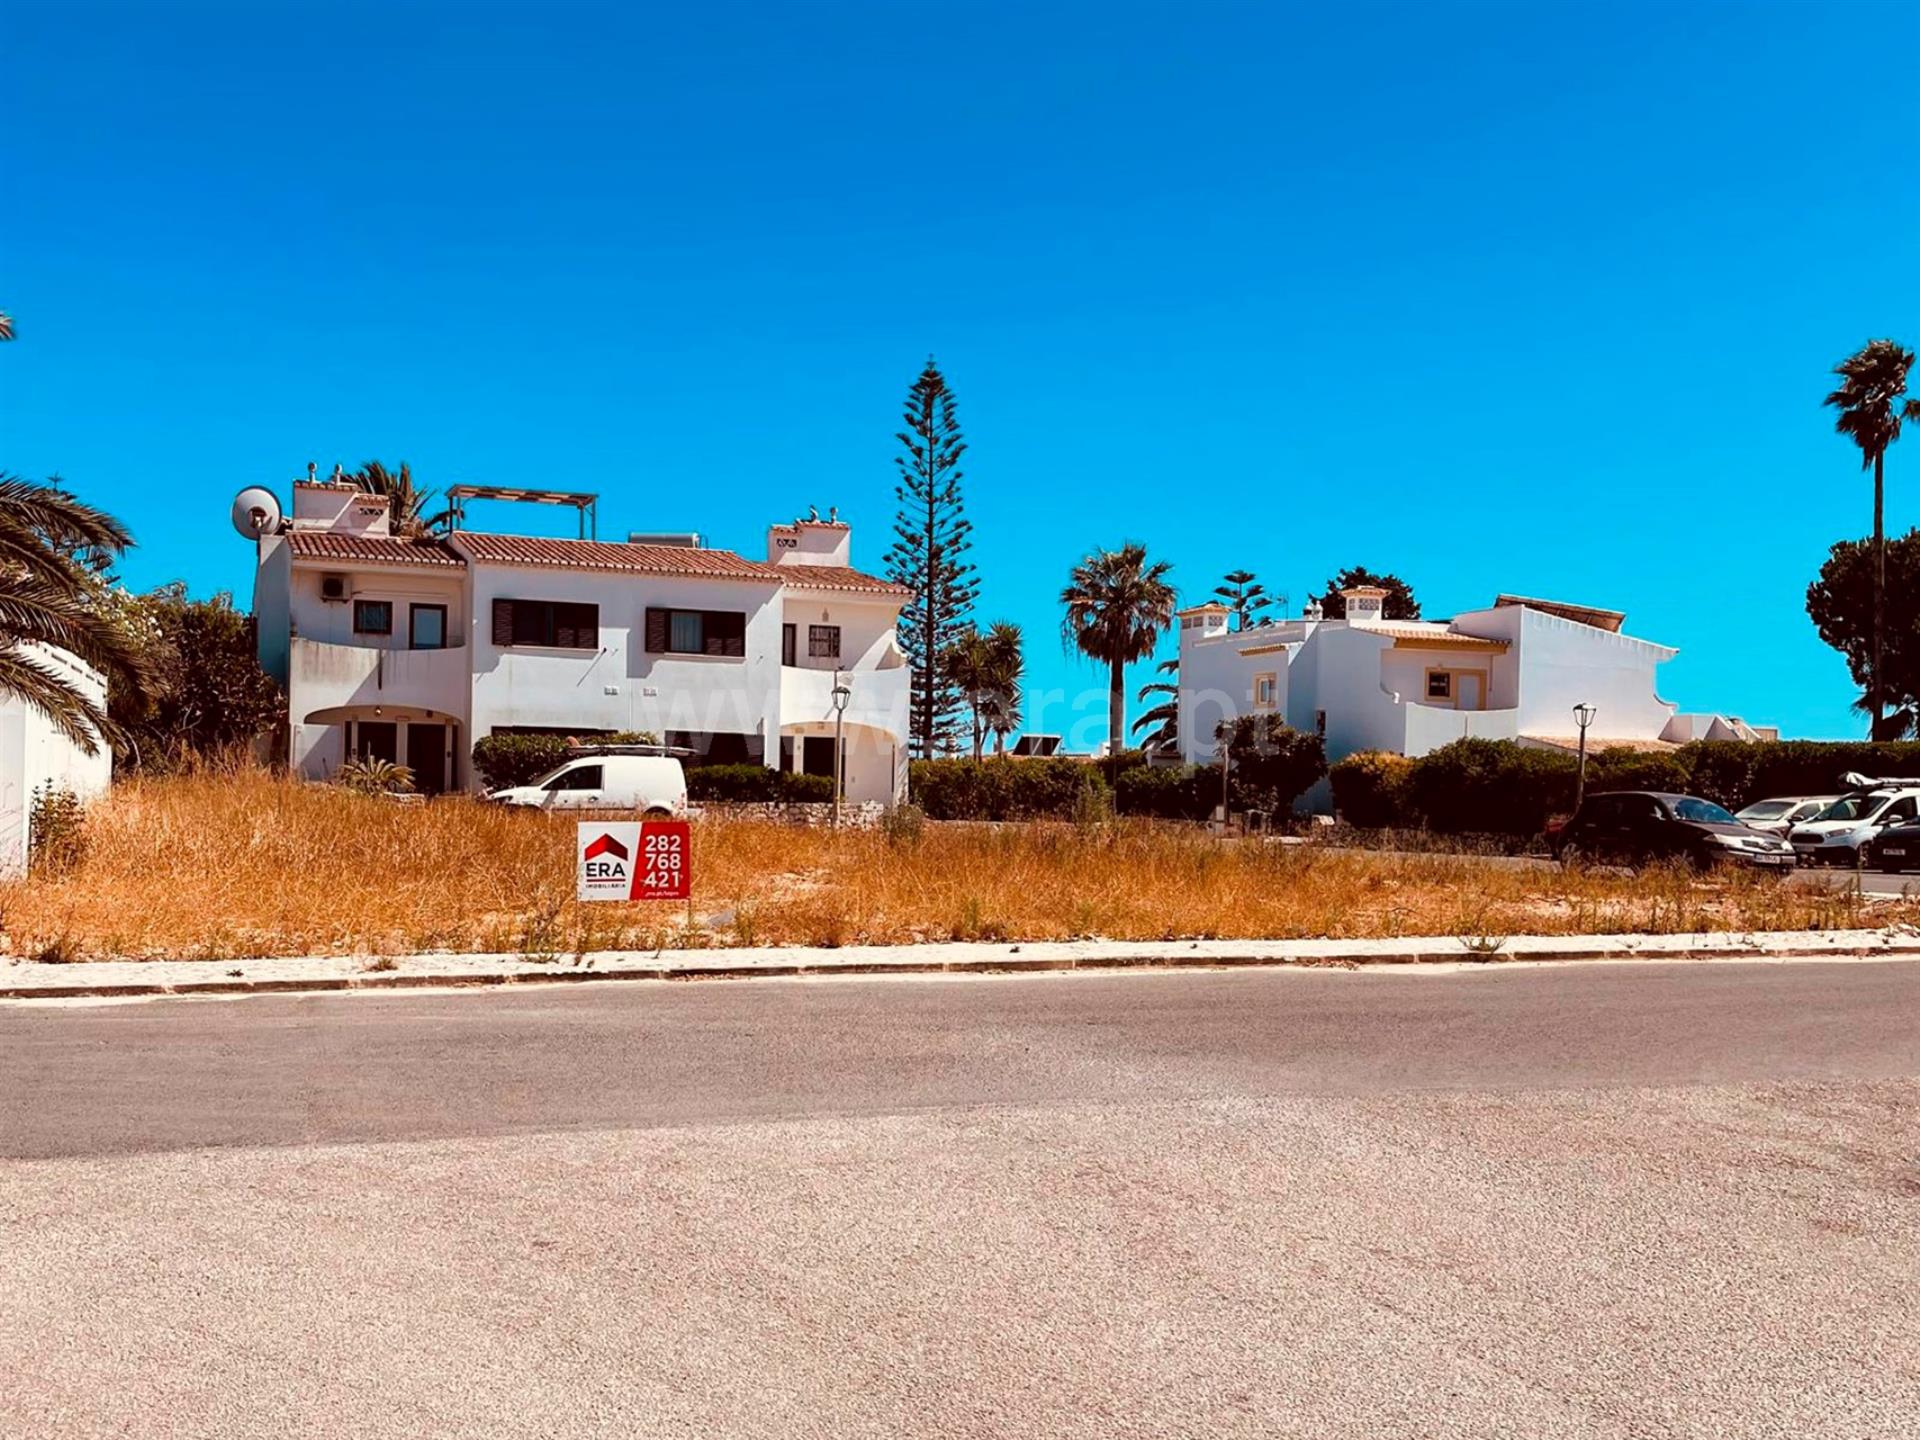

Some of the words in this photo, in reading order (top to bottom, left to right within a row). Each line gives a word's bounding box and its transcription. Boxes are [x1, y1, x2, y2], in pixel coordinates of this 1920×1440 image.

[645, 835, 681, 851] 282
[645, 853, 681, 870] 768
[586, 863, 626, 877] ERA
[644, 872, 679, 888] 421
